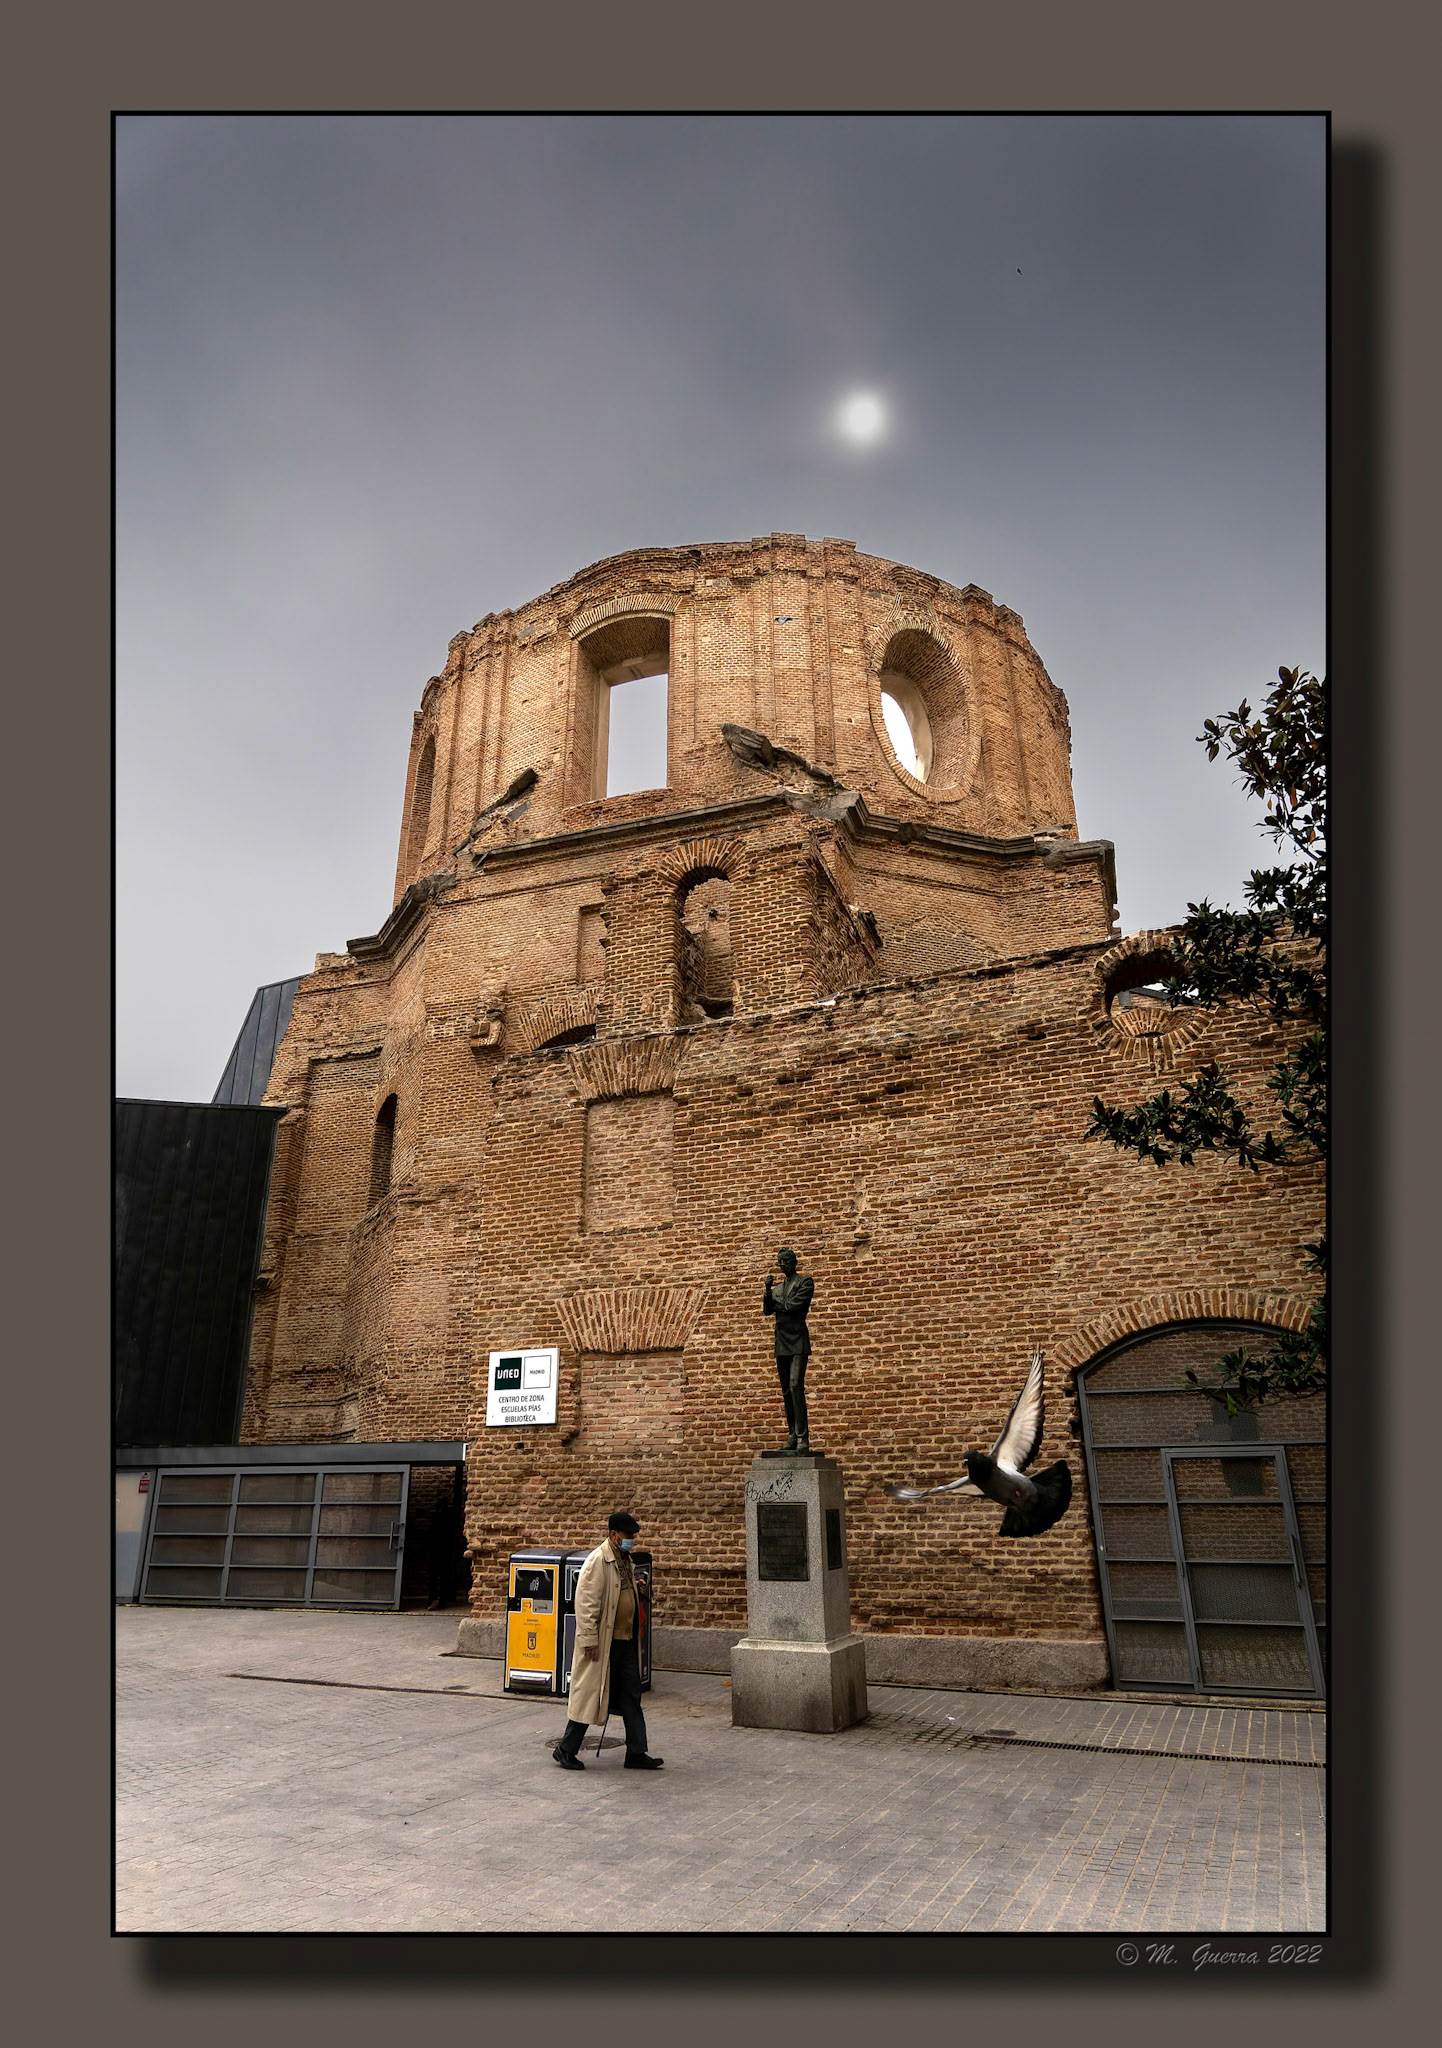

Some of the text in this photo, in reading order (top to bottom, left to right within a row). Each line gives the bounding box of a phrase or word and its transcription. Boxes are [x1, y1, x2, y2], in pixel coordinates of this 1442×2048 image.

[497, 1369, 519, 1379] UNED
[528, 1404, 541, 1412] PÍAS
[505, 1415, 536, 1423] BIBLIOTECA
